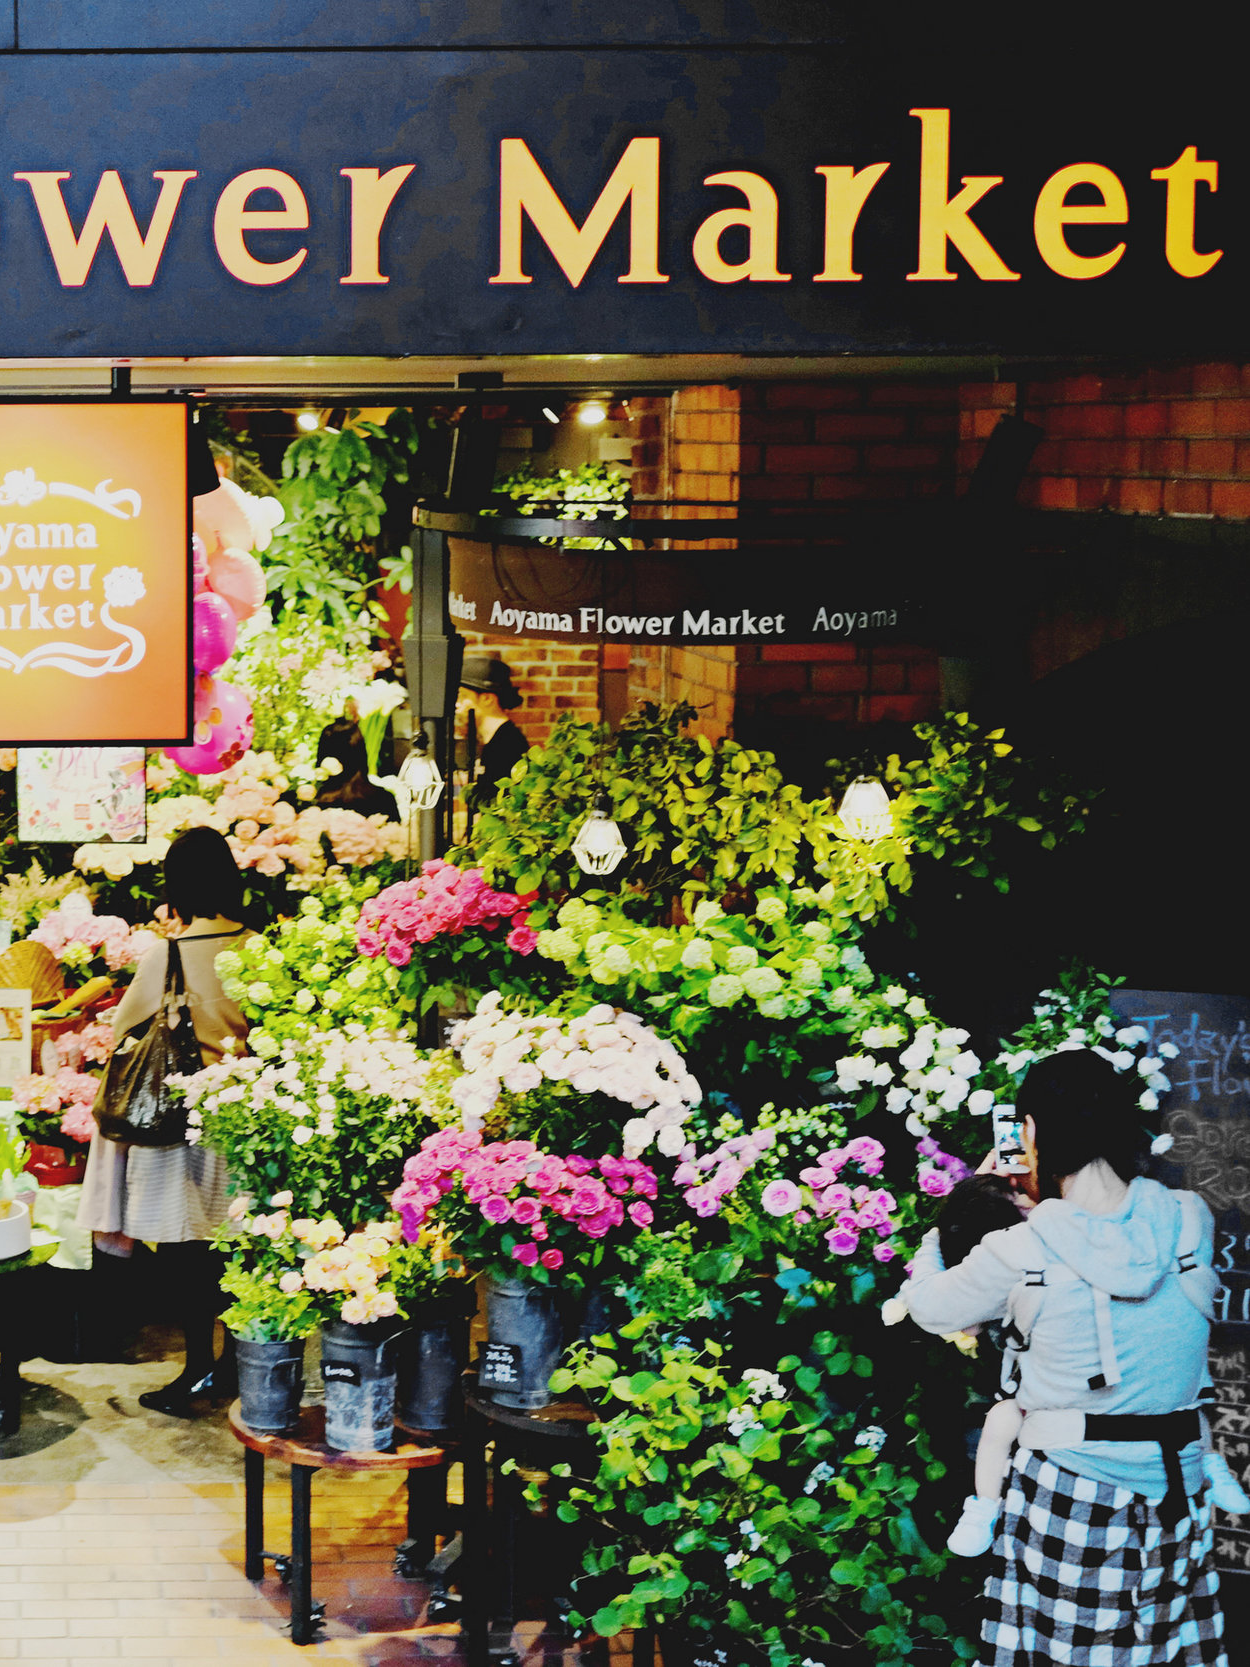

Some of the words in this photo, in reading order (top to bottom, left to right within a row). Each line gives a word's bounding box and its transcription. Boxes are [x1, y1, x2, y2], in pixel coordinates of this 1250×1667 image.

[488, 108, 1224, 288] Market
[488, 600, 575, 635] Aoyama
[578, 607, 675, 636] Flower
[681, 609, 786, 636] Market
[811, 606, 897, 637] Aoyama
